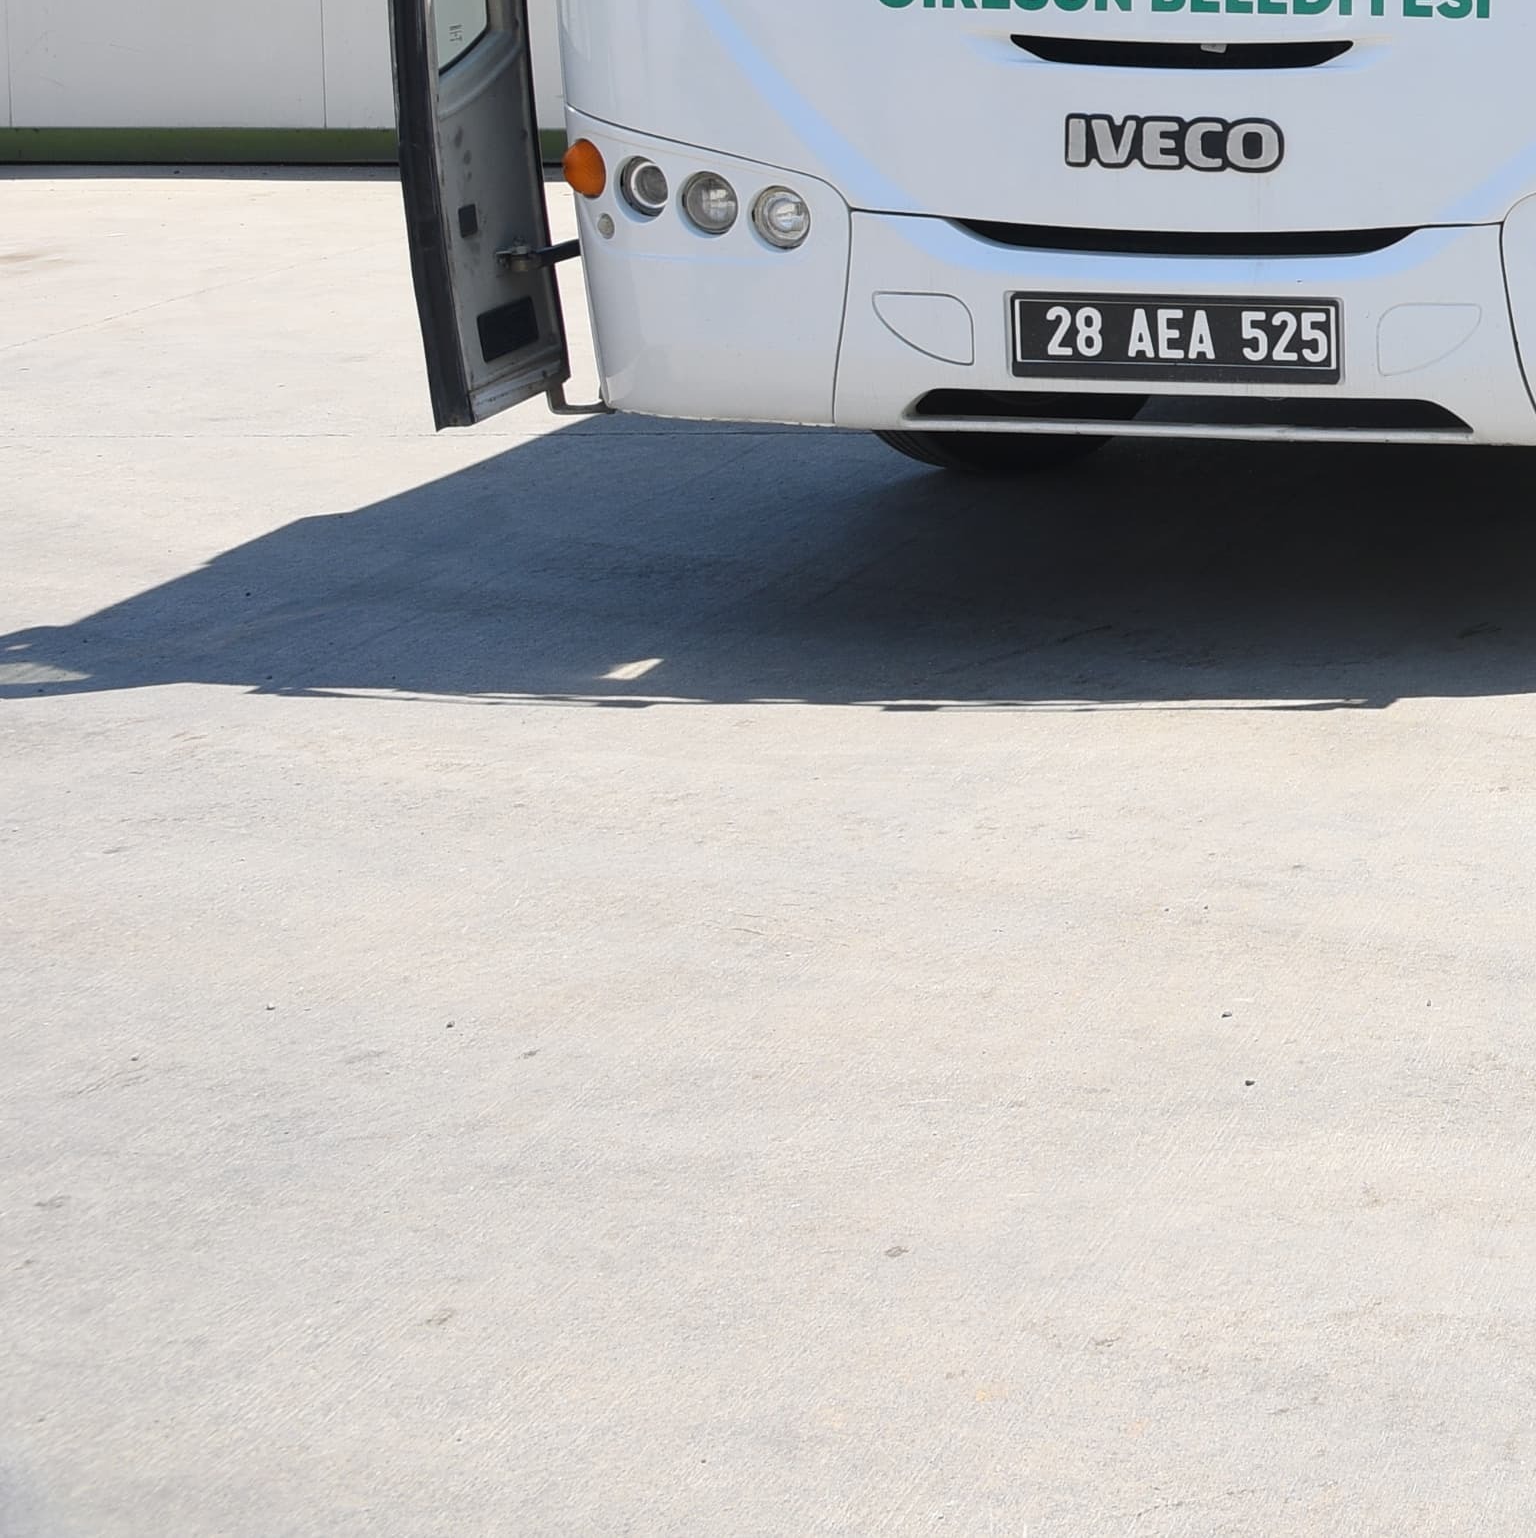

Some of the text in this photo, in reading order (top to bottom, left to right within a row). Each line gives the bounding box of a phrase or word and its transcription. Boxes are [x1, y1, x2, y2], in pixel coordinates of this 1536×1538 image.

[1065, 113, 1285, 173] IVECO
[1045, 306, 1329, 362] 28 AEA 525
